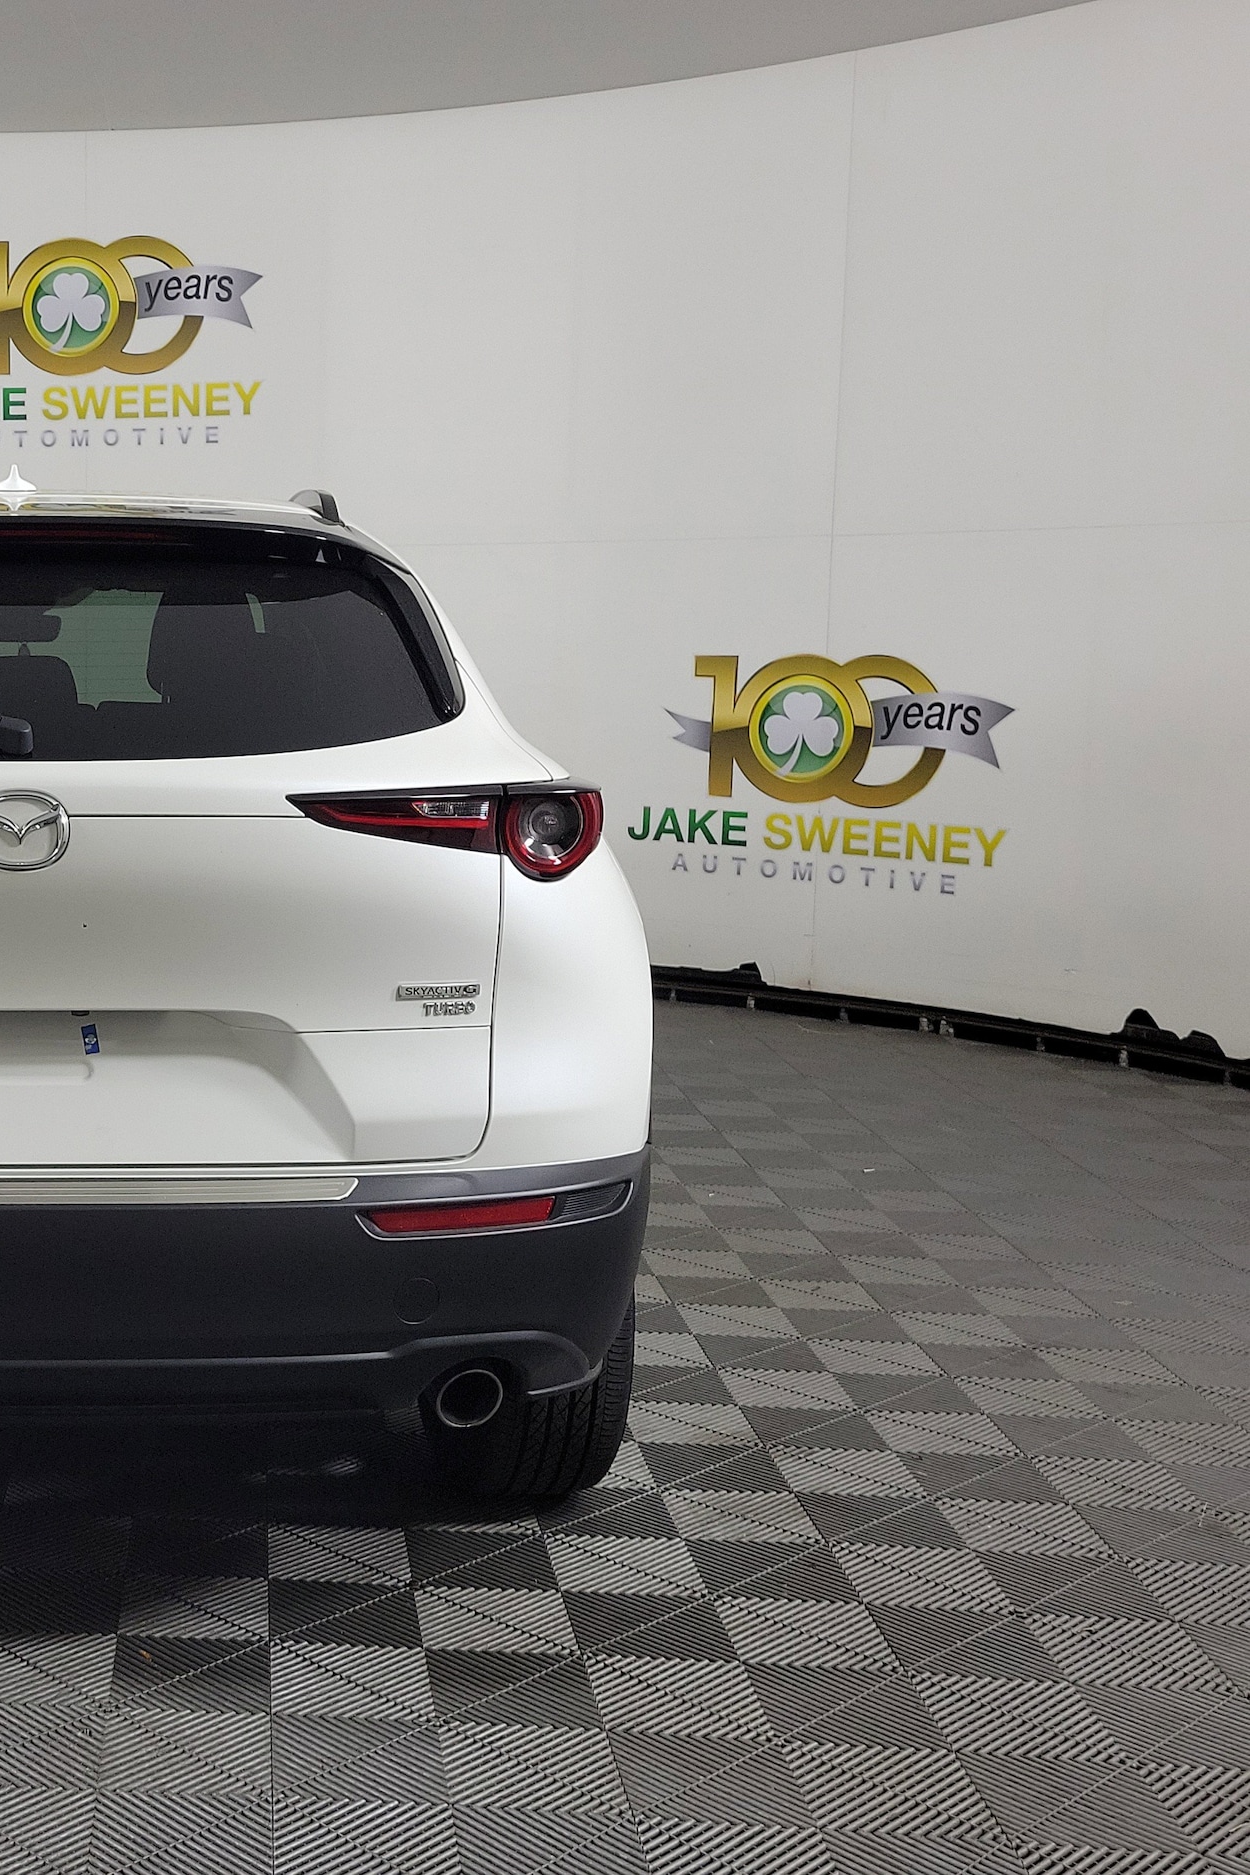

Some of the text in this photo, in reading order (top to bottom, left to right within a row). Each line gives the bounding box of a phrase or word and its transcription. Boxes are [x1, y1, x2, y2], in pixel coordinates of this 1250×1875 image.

[144, 271, 234, 312] years
[41, 380, 262, 420] SWEENEY
[694, 653, 982, 809] 100 years
[627, 806, 1008, 868] JAKE SWEENEY
[671, 852, 957, 896] AUTOMOTIVE
[423, 1001, 476, 1017] TURBO
